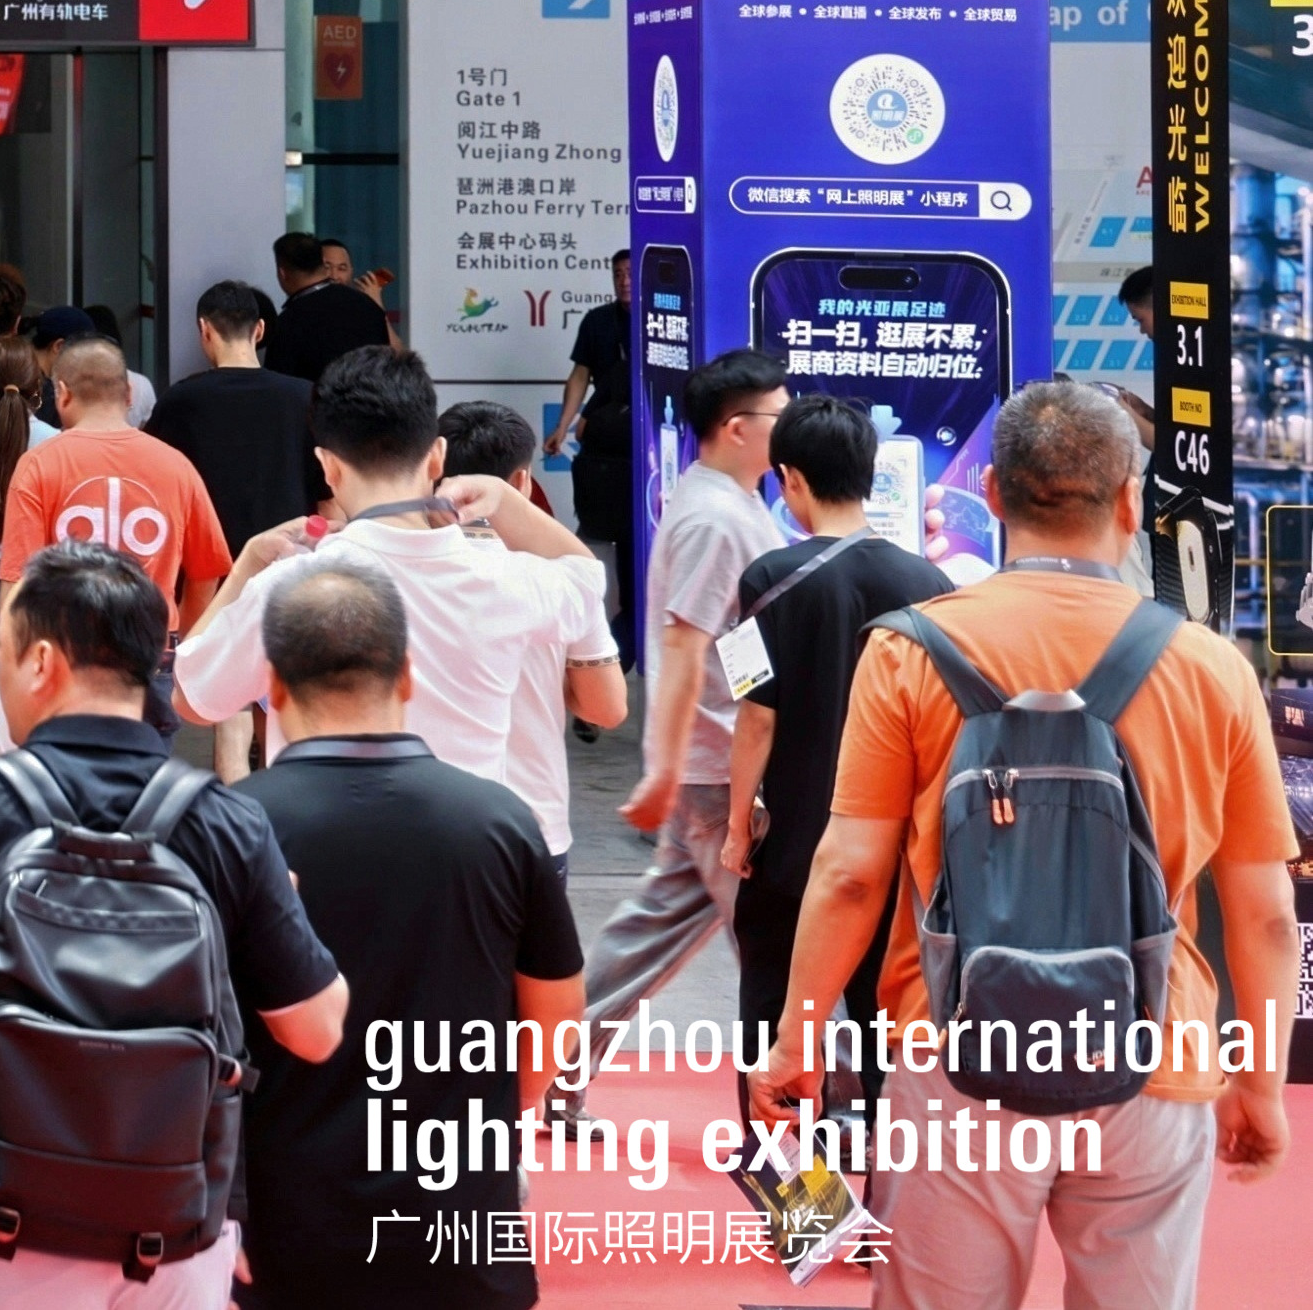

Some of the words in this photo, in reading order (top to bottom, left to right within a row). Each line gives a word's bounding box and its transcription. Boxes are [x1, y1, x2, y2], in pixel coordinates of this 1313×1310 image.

[2, 2, 109, 22] 广州有轨电车
[738, 3, 792, 19] 全球参展
[813, 5, 867, 20] 全球直播
[888, 6, 942, 21] 全球发布
[963, 7, 1017, 22] 全球贸易
[322, 24, 357, 40] AED
[456, 67, 508, 87] 1号门
[456, 90, 506, 107] Gate
[512, 91, 521, 107] 1
[457, 120, 542, 140] 阅江中路
[456, 143, 550, 163] Yuejiang
[555, 143, 622, 164] Zhong
[455, 198, 529, 216] Pazhou
[534, 199, 586, 219] Ferry
[457, 231, 577, 251] 会展中心码头
[455, 253, 559, 270] Exhibition
[560, 290, 617, 305] Guang
[1171, 293, 1195, 307] EXHIBITION
[817, 298, 947, 318] 我的光亚展足迹
[1177, 323, 1203, 368] 3.1
[1179, 400, 1194, 413] BOOTH
[1175, 430, 1210, 475] C46
[54, 476, 169, 558] alo
